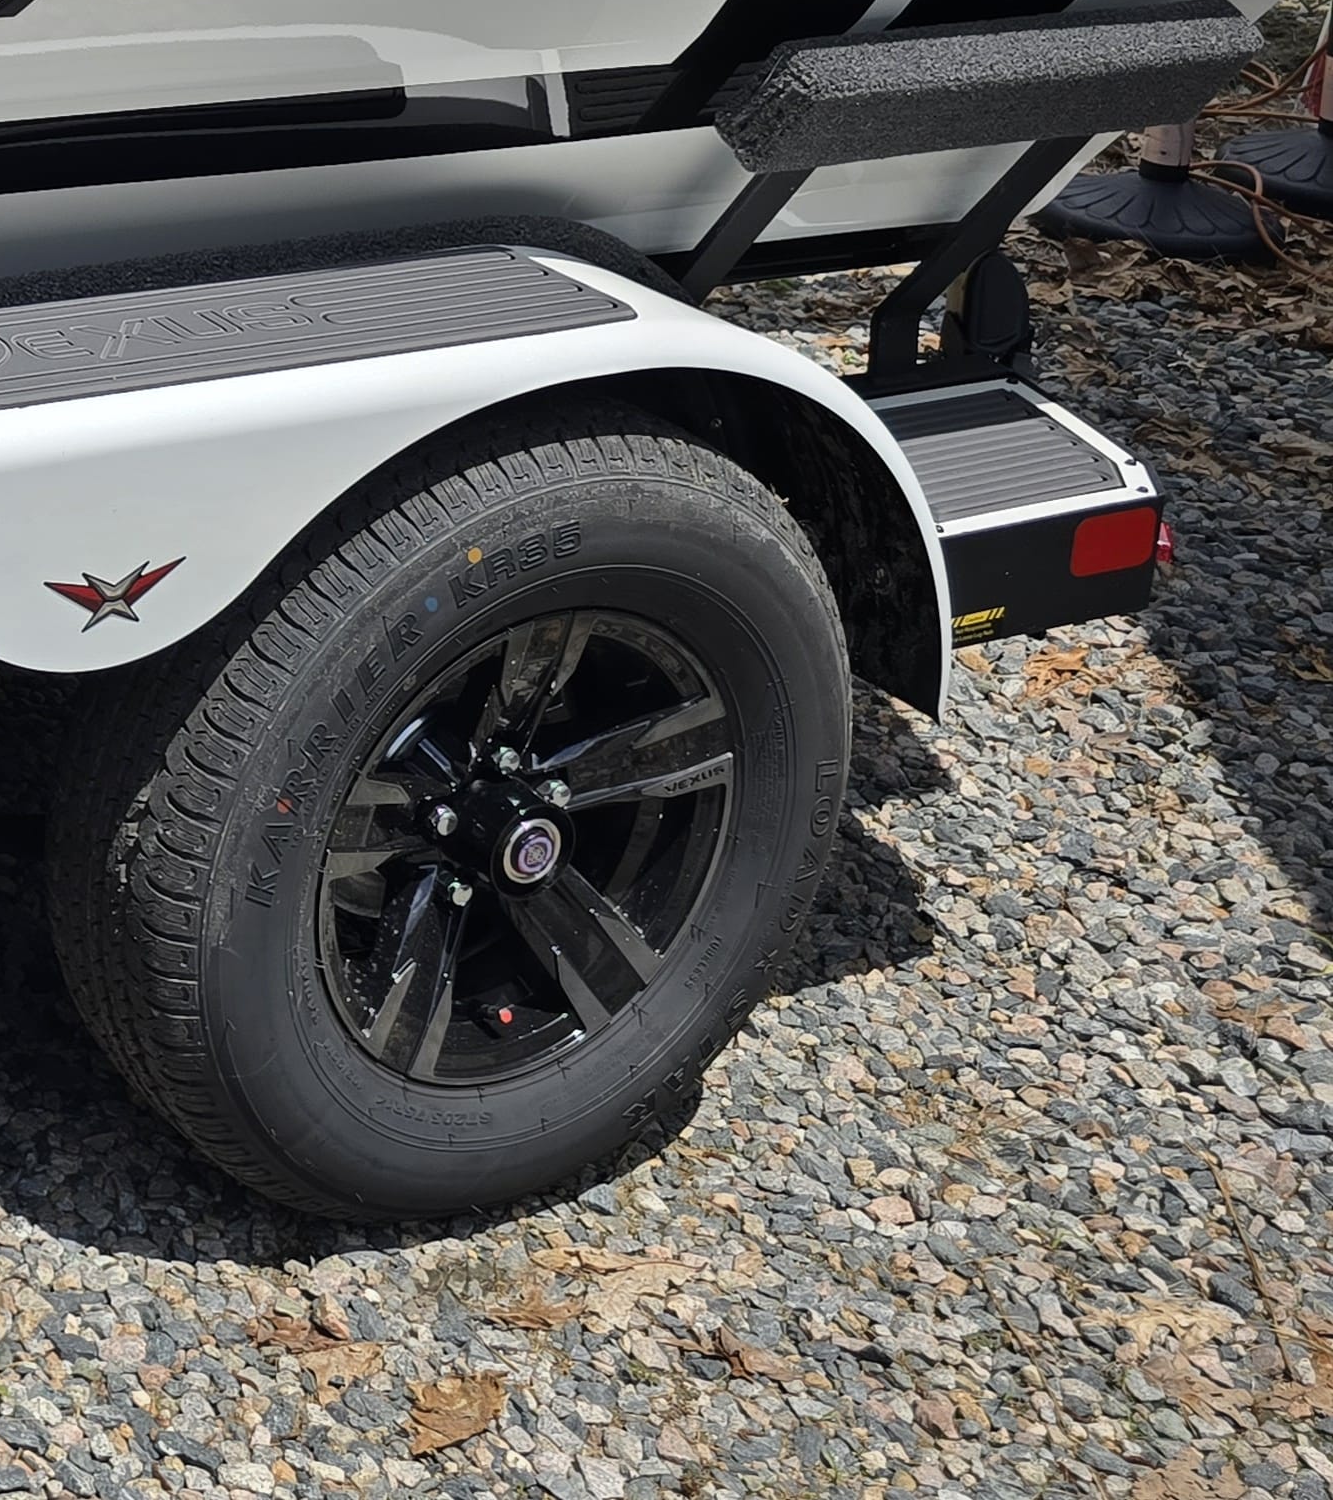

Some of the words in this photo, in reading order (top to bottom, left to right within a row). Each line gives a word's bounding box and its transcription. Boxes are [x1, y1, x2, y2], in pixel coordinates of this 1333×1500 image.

[245, 611, 424, 908] KARRIER
[448, 520, 582, 609] KR35
[663, 764, 726, 794] VEXUS
[779, 759, 840, 933] LOAD
